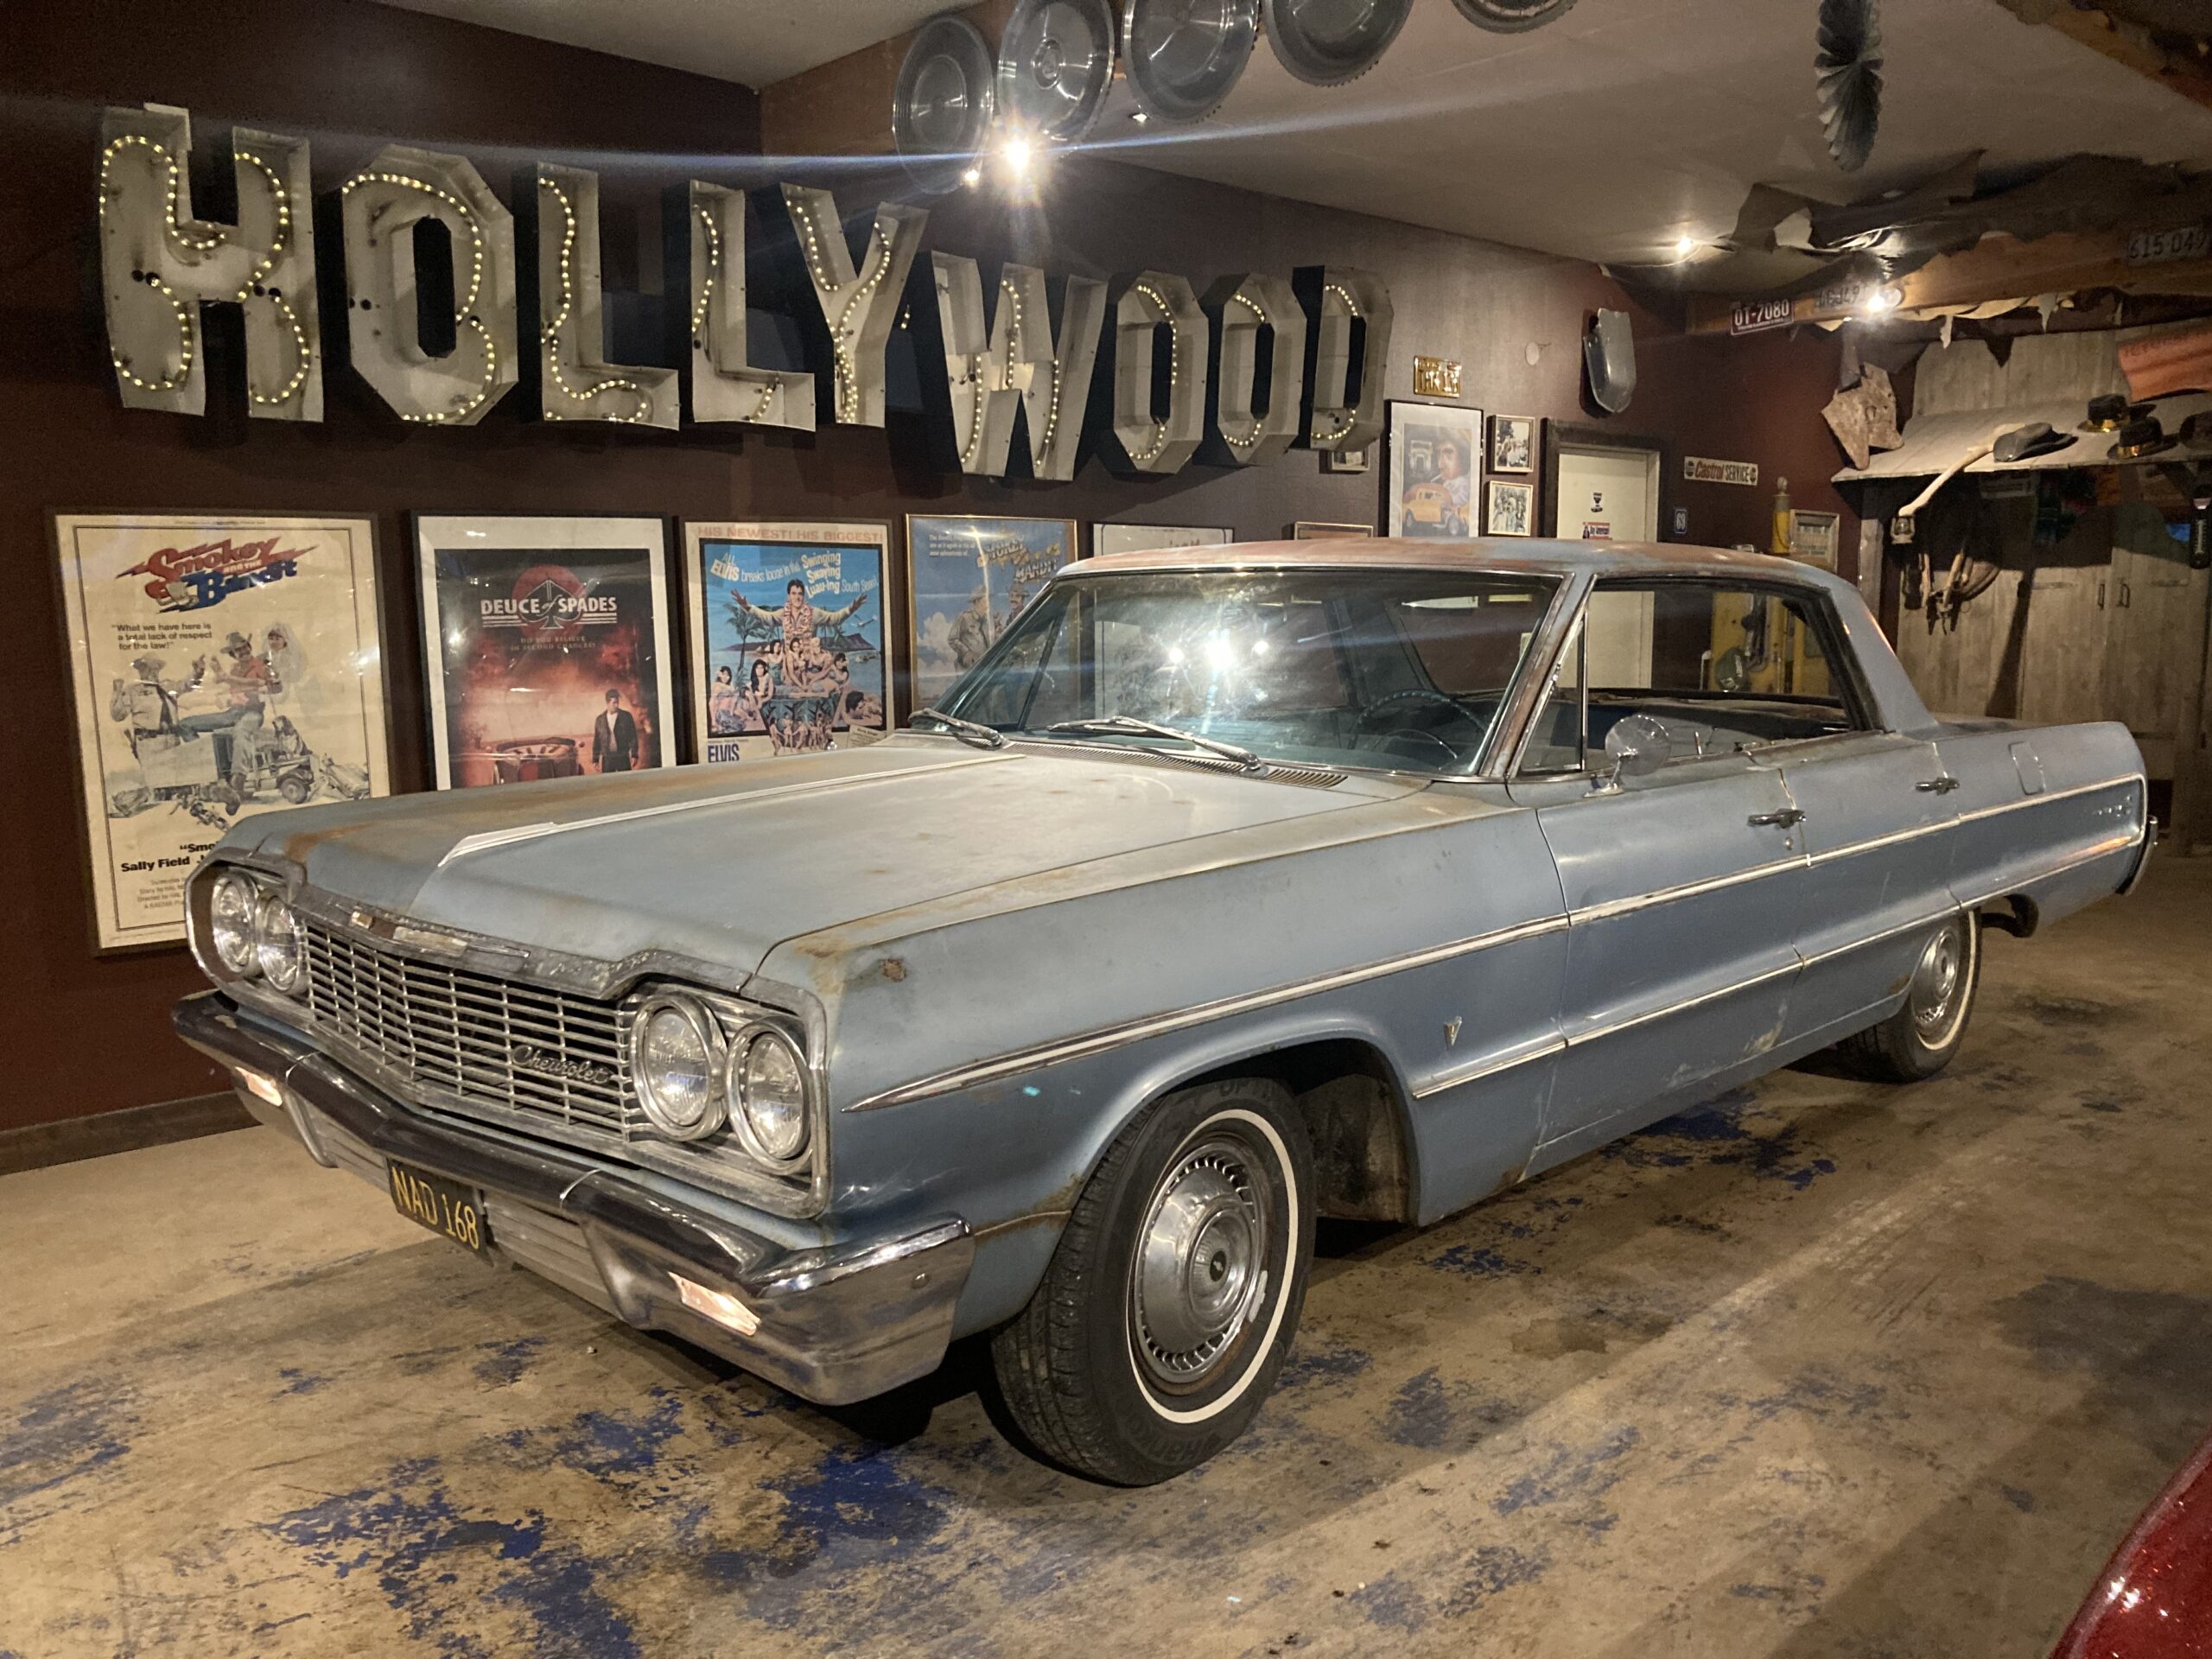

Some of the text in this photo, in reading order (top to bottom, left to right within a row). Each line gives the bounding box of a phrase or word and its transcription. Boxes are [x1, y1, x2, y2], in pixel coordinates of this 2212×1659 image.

[99, 101, 1394, 480] HOLLYWOOD
[1694, 461, 1749, 483] Castrol SERVICE
[698, 526, 883, 542] HIS NEWEST! HIS BIGGEST!
[138, 536, 283, 600] Smokey
[801, 550, 841, 569] Swinging
[710, 558, 740, 582] ELVIS
[741, 569, 765, 582] breaks
[842, 579, 860, 593] South
[480, 598, 540, 614] DEUCE
[557, 596, 617, 613] SPADES
[179, 632, 213, 640] respect
[708, 743, 741, 763] ELVIS
[180, 842, 216, 853] "Smo
[121, 861, 155, 872] Sally
[157, 856, 190, 868] Field
[512, 1044, 610, 1084] Chevrolet
[391, 1166, 479, 1249] NAD 168
